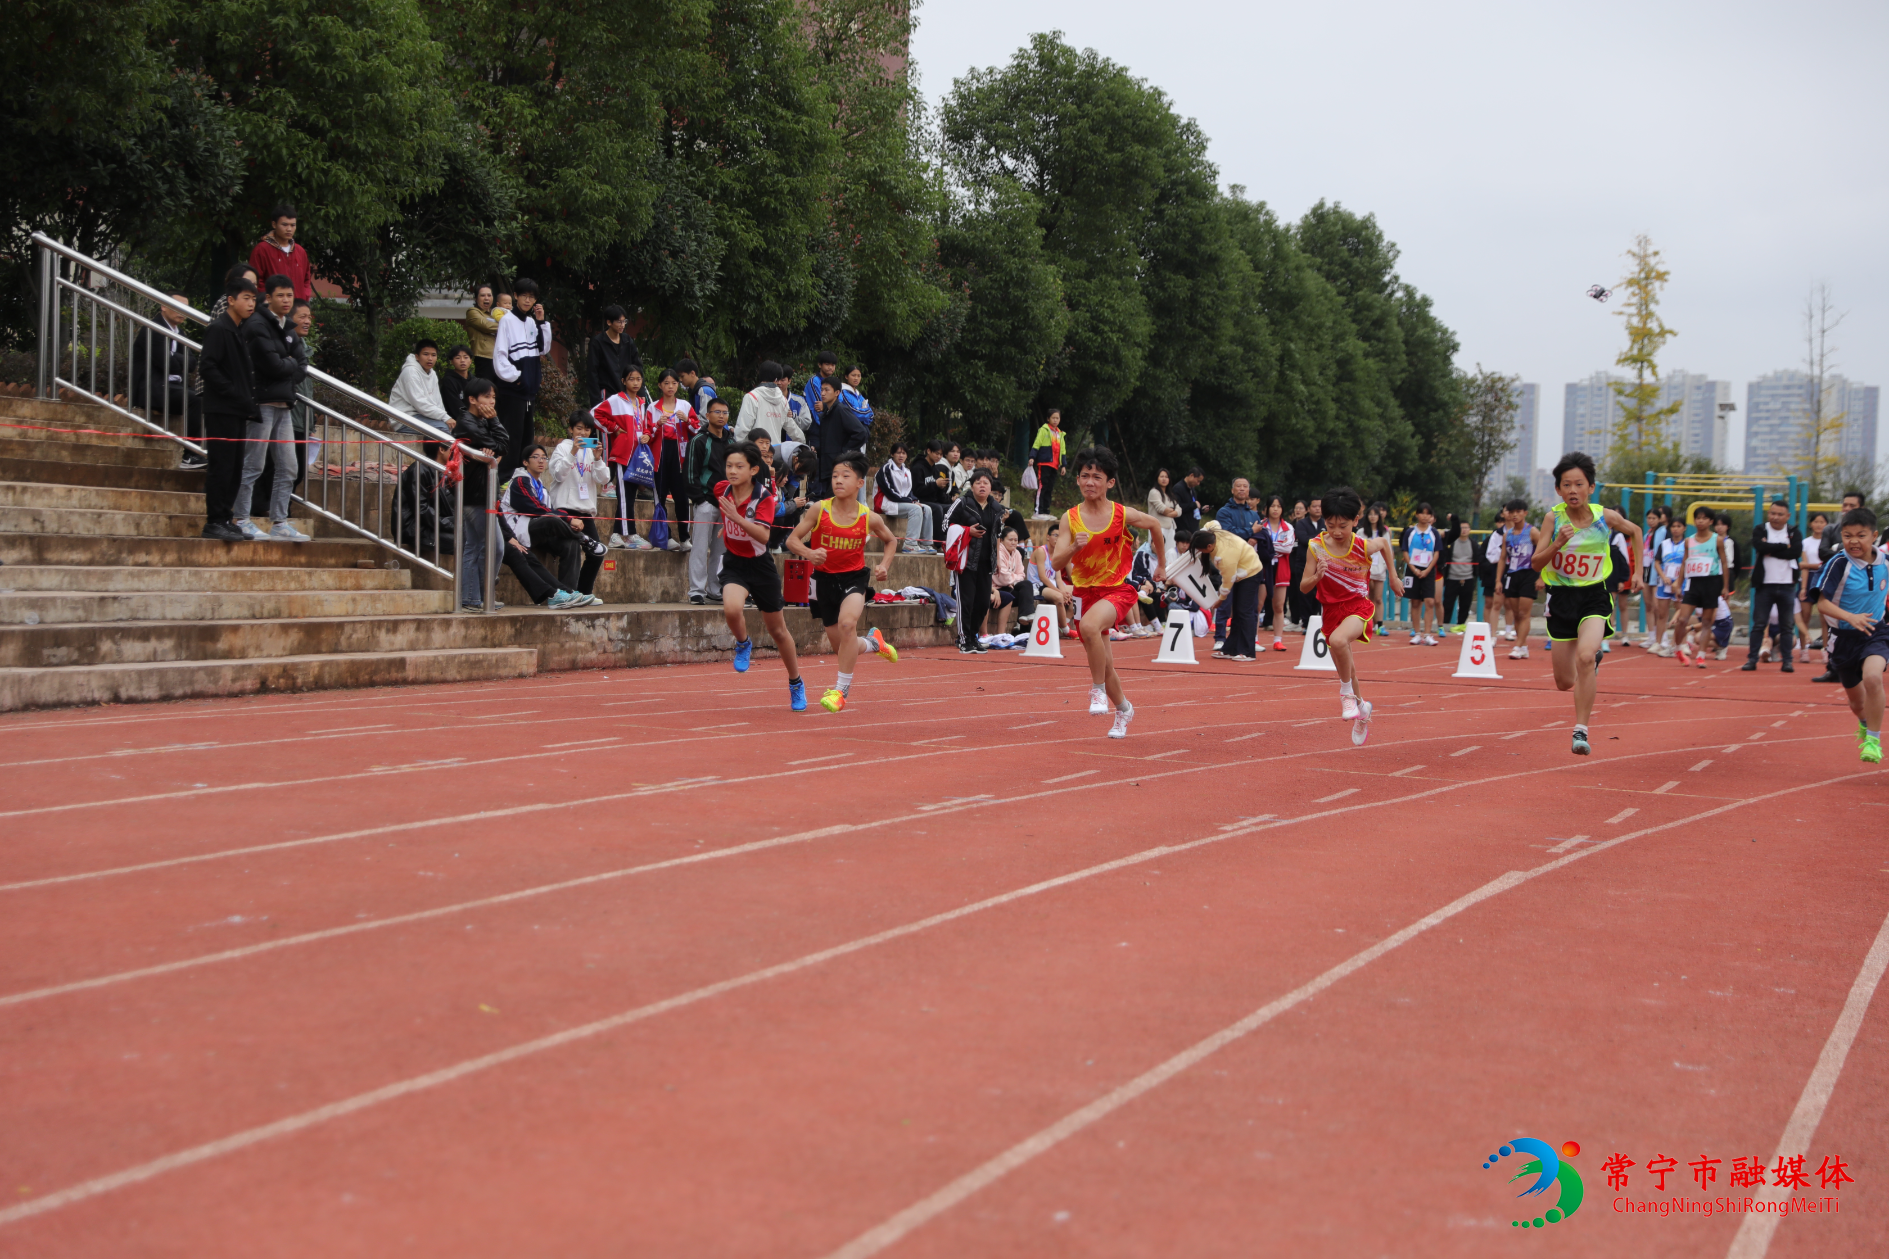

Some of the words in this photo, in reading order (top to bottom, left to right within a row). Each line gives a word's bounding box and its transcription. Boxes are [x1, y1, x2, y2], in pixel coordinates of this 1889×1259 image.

[727, 520, 751, 537] 089
[820, 533, 862, 550] CHINA
[1551, 551, 1603, 578] 0857
[1686, 562, 1710, 574] 0461
[1187, 574, 1207, 598] 1
[1405, 578, 1410, 586] 6
[1036, 616, 1050, 646] 8
[1169, 622, 1184, 652] 7
[1313, 628, 1328, 658] 6
[1470, 635, 1486, 666] 5
